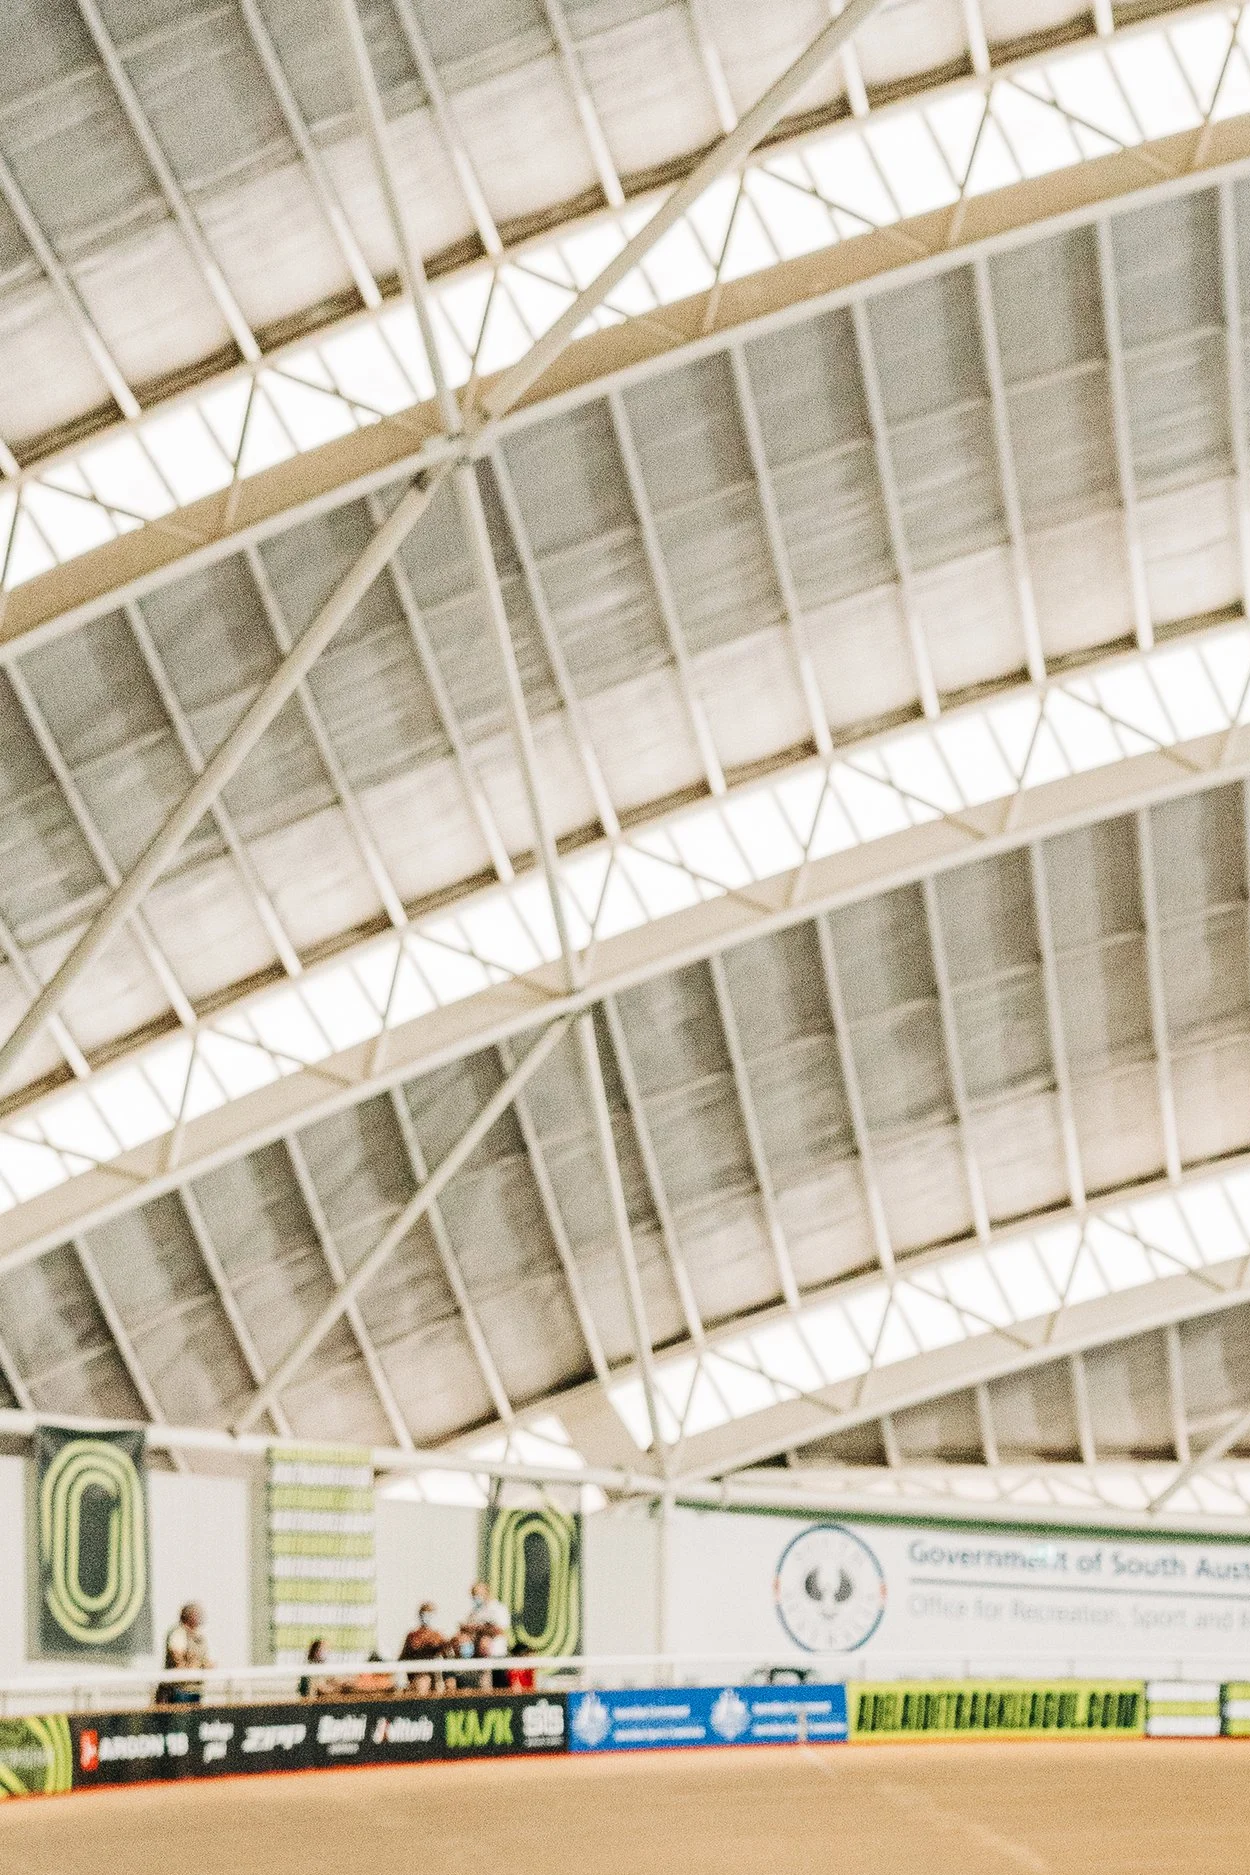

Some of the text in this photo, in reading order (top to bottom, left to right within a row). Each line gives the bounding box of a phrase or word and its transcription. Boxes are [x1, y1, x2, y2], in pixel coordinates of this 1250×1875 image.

[908, 1540, 1068, 1574] Government
[1075, 1549, 1104, 1574] of
[1110, 1553, 1187, 1579] South
[909, 1594, 968, 1619] Office
[974, 1598, 1002, 1620] for
[1132, 1605, 1187, 1632] Sport
[1194, 1608, 1234, 1630] and
